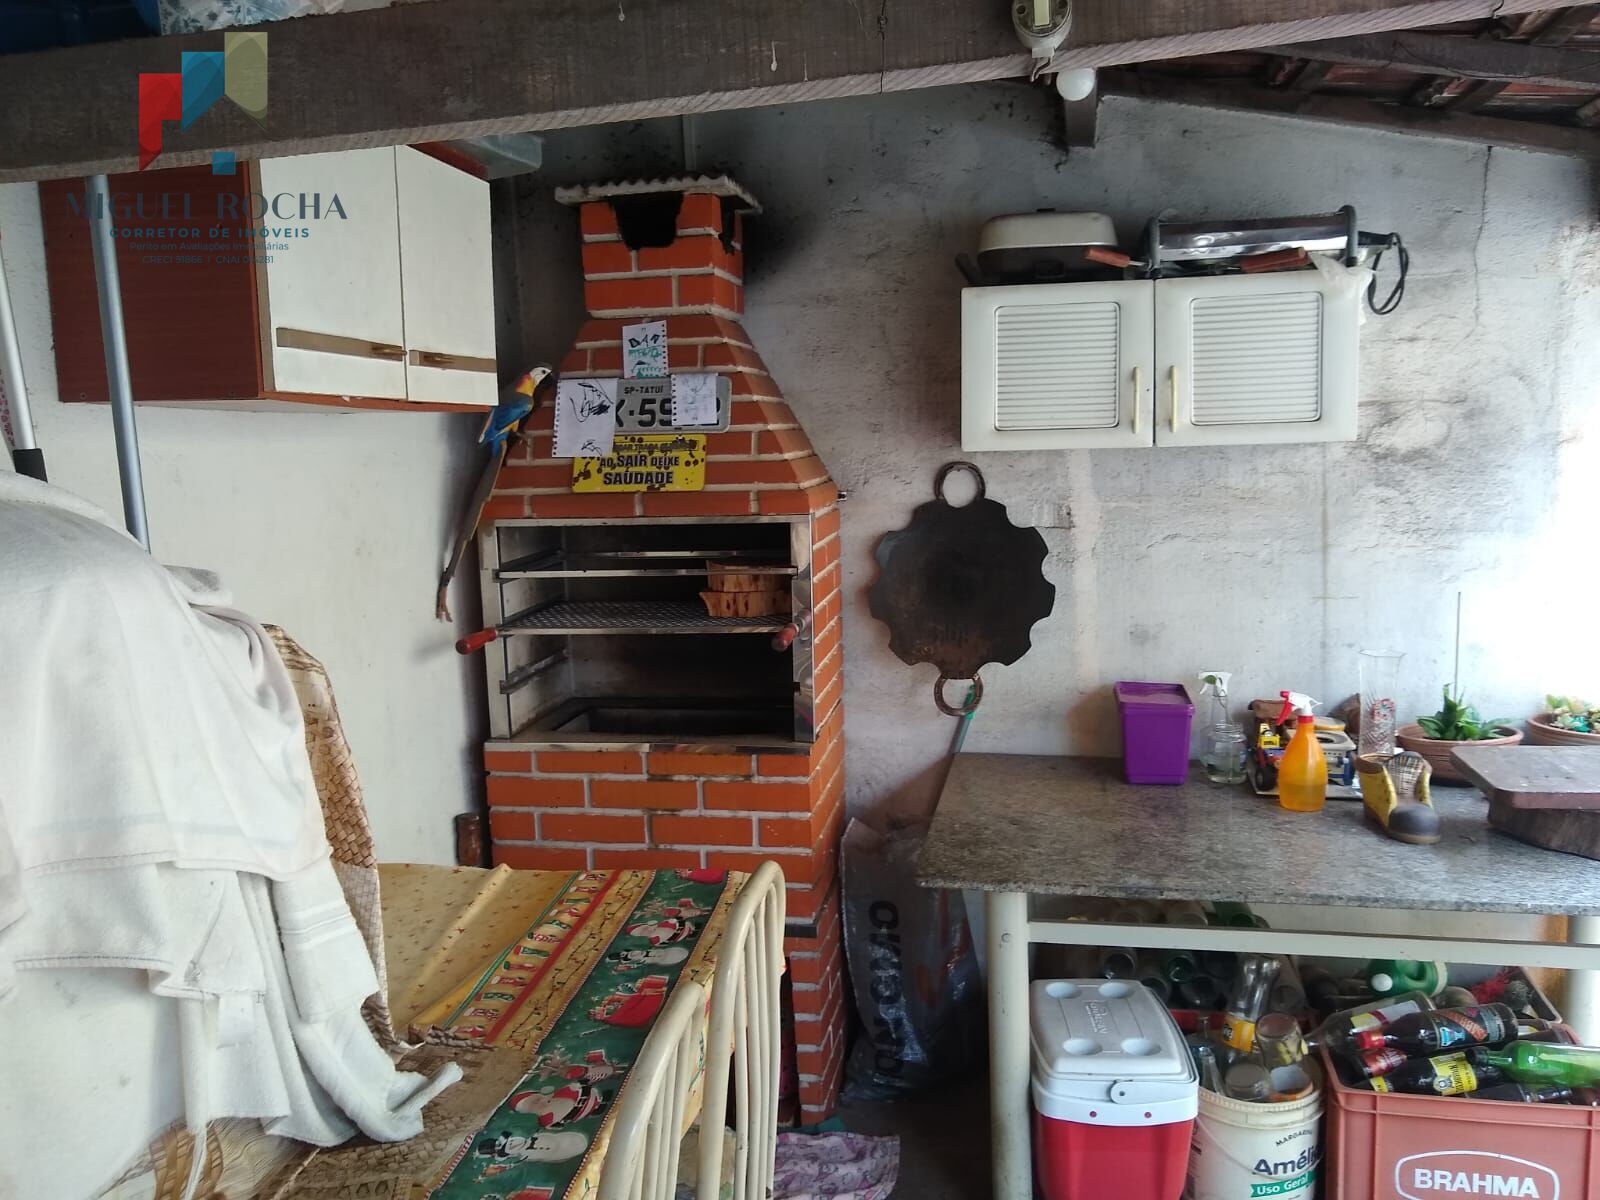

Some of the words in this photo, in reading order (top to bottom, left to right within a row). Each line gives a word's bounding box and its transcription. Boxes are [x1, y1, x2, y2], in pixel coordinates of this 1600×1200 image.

[600, 456, 613, 467] AO
[616, 454, 647, 468] SAIR
[651, 455, 679, 467] DEIXE
[603, 471, 673, 485] SAUDADE
[1256, 1184, 1280, 1195] Uso
[1284, 1174, 1309, 1190] Geral
[1413, 1168, 1540, 1198] BRAHMA
